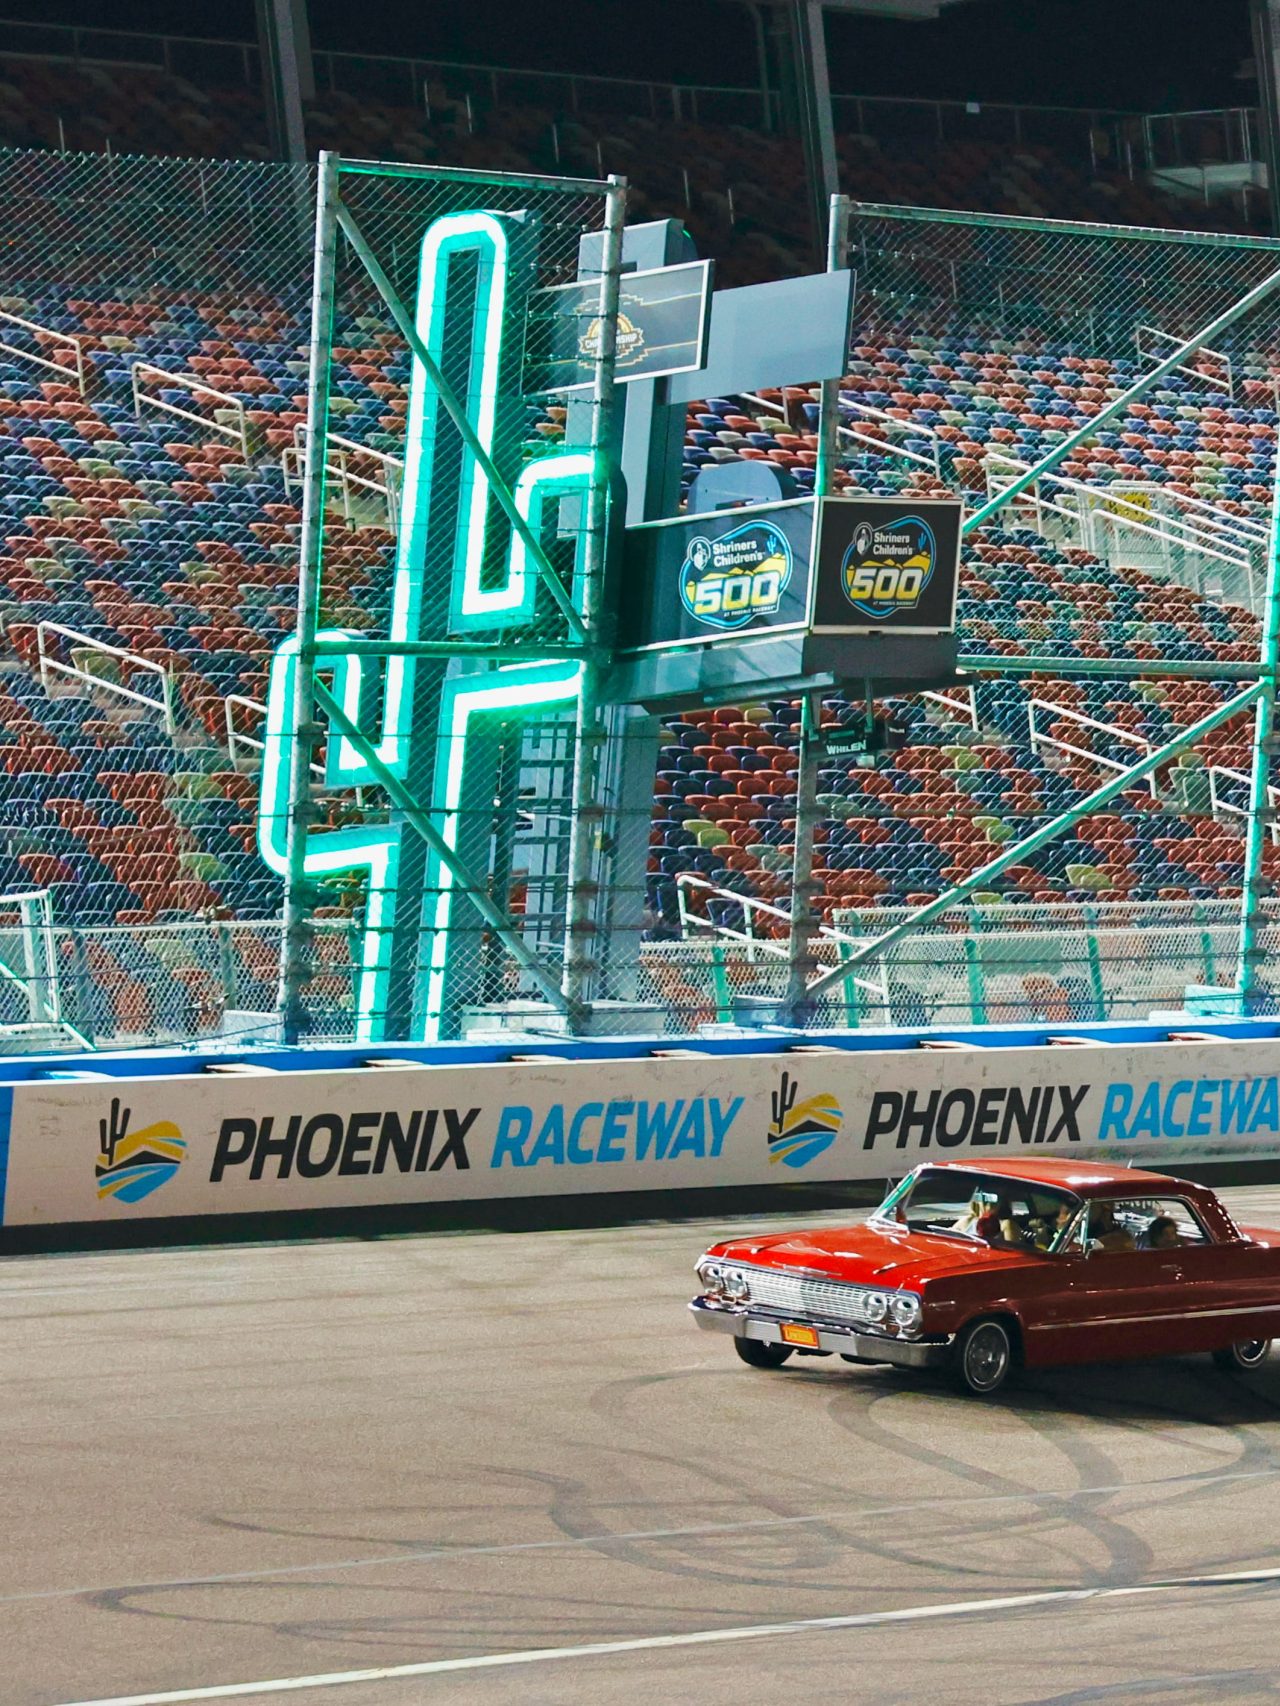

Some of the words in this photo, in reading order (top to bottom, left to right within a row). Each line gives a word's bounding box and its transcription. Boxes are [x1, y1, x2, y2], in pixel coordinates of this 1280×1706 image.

[712, 540, 757, 555] Shriners
[872, 532, 910, 543] Shriners
[713, 552, 763, 568] Children's
[873, 545, 913, 555] Children's
[694, 570, 781, 616] 500
[850, 567, 923, 600] 500
[863, 1085, 1092, 1151] PHOENIX
[210, 1108, 482, 1183] PHOENIX
[490, 1096, 745, 1169] RACEWAY
